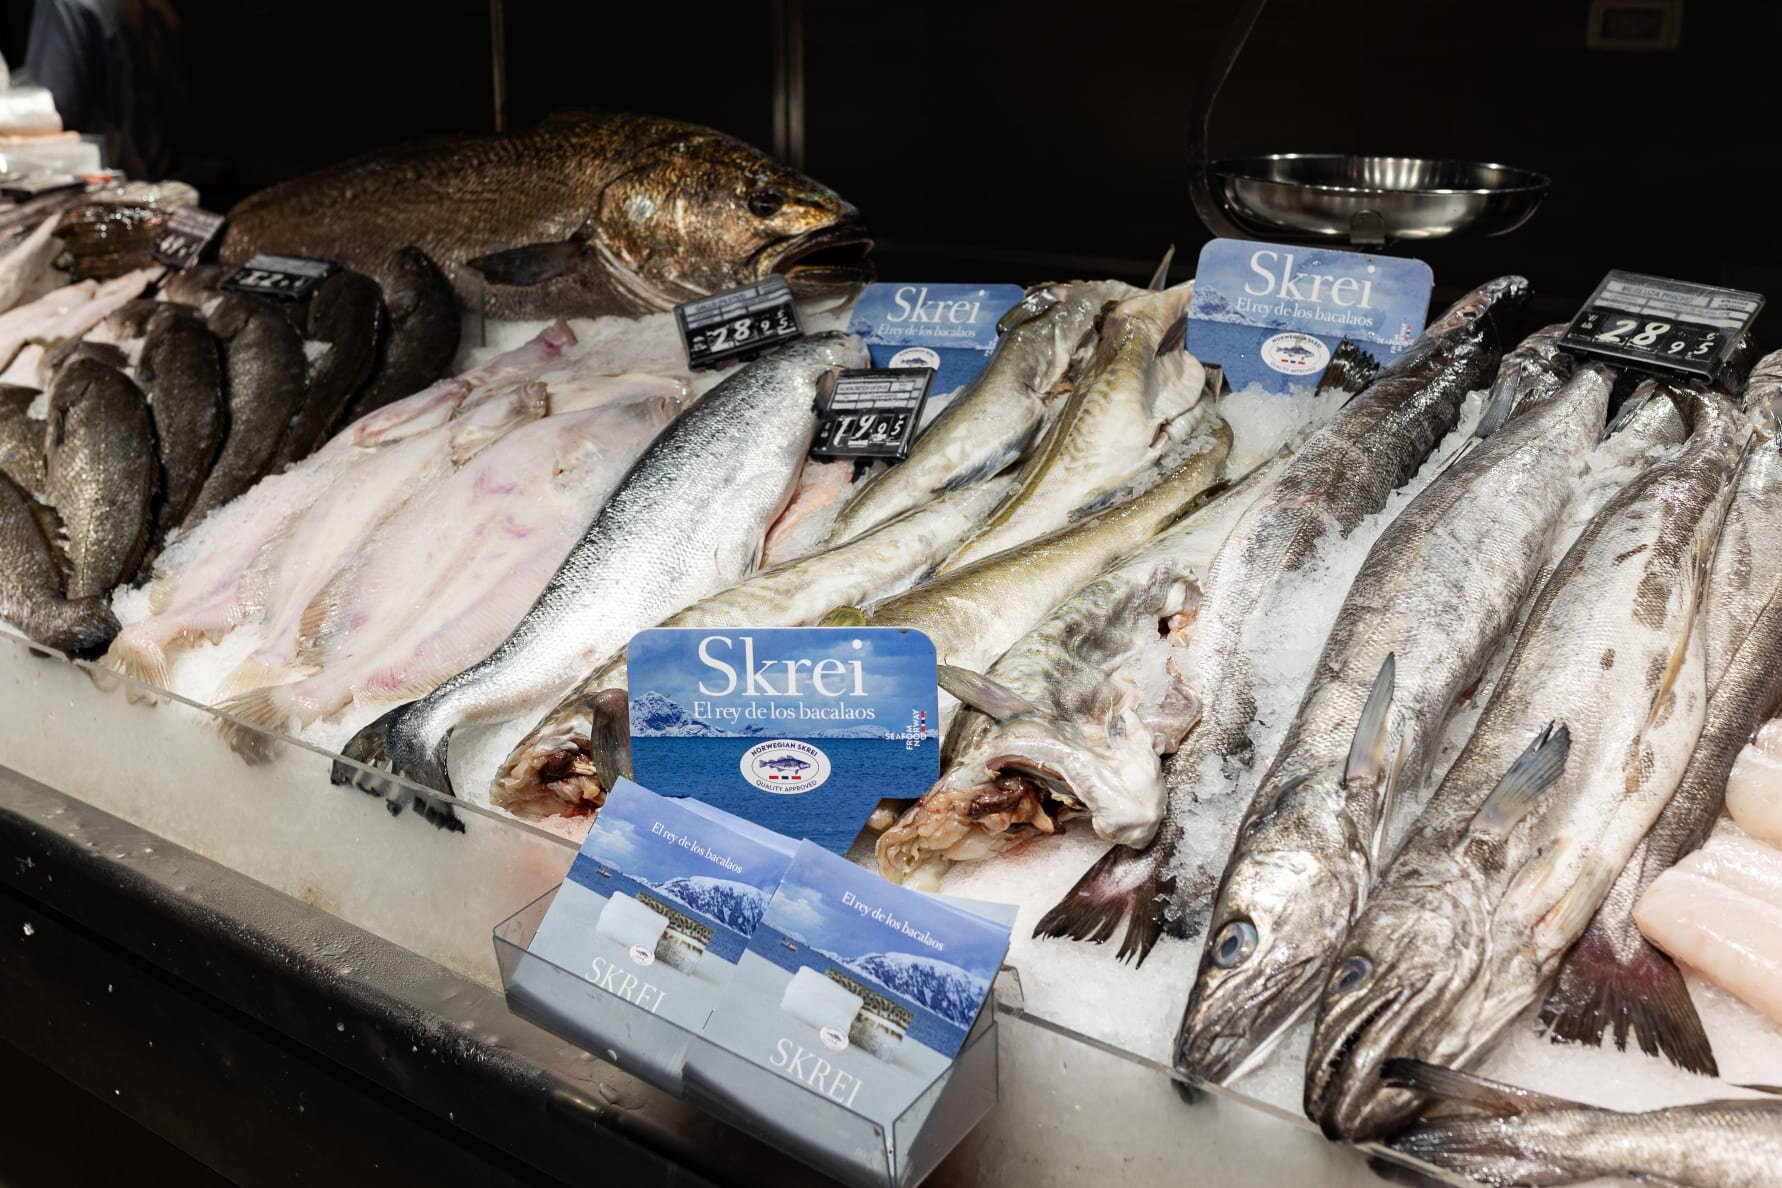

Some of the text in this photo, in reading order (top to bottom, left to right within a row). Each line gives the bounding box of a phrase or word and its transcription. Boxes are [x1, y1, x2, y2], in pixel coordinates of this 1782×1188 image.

[1244, 250, 1376, 309] Skrei
[886, 286, 986, 324] Skrei
[1235, 297, 1373, 327] El rey de los bacalaos
[878, 323, 892, 336] El
[905, 325, 918, 336] de
[918, 325, 933, 336] los
[934, 325, 976, 337] bacalaos
[1595, 319, 1671, 346] 28
[698, 635, 869, 697] Skrei
[693, 701, 875, 725] El rey de los bacalaos
[912, 709, 921, 747] NORWAY
[751, 742, 818, 757] NORWEGIAN SKREI
[756, 779, 817, 792] QUALITY APPROVED
[651, 821, 743, 875] El rey de los bacalaos
[841, 890, 945, 951] El rey de los bacalaos
[769, 1037, 864, 1110] SKREI
